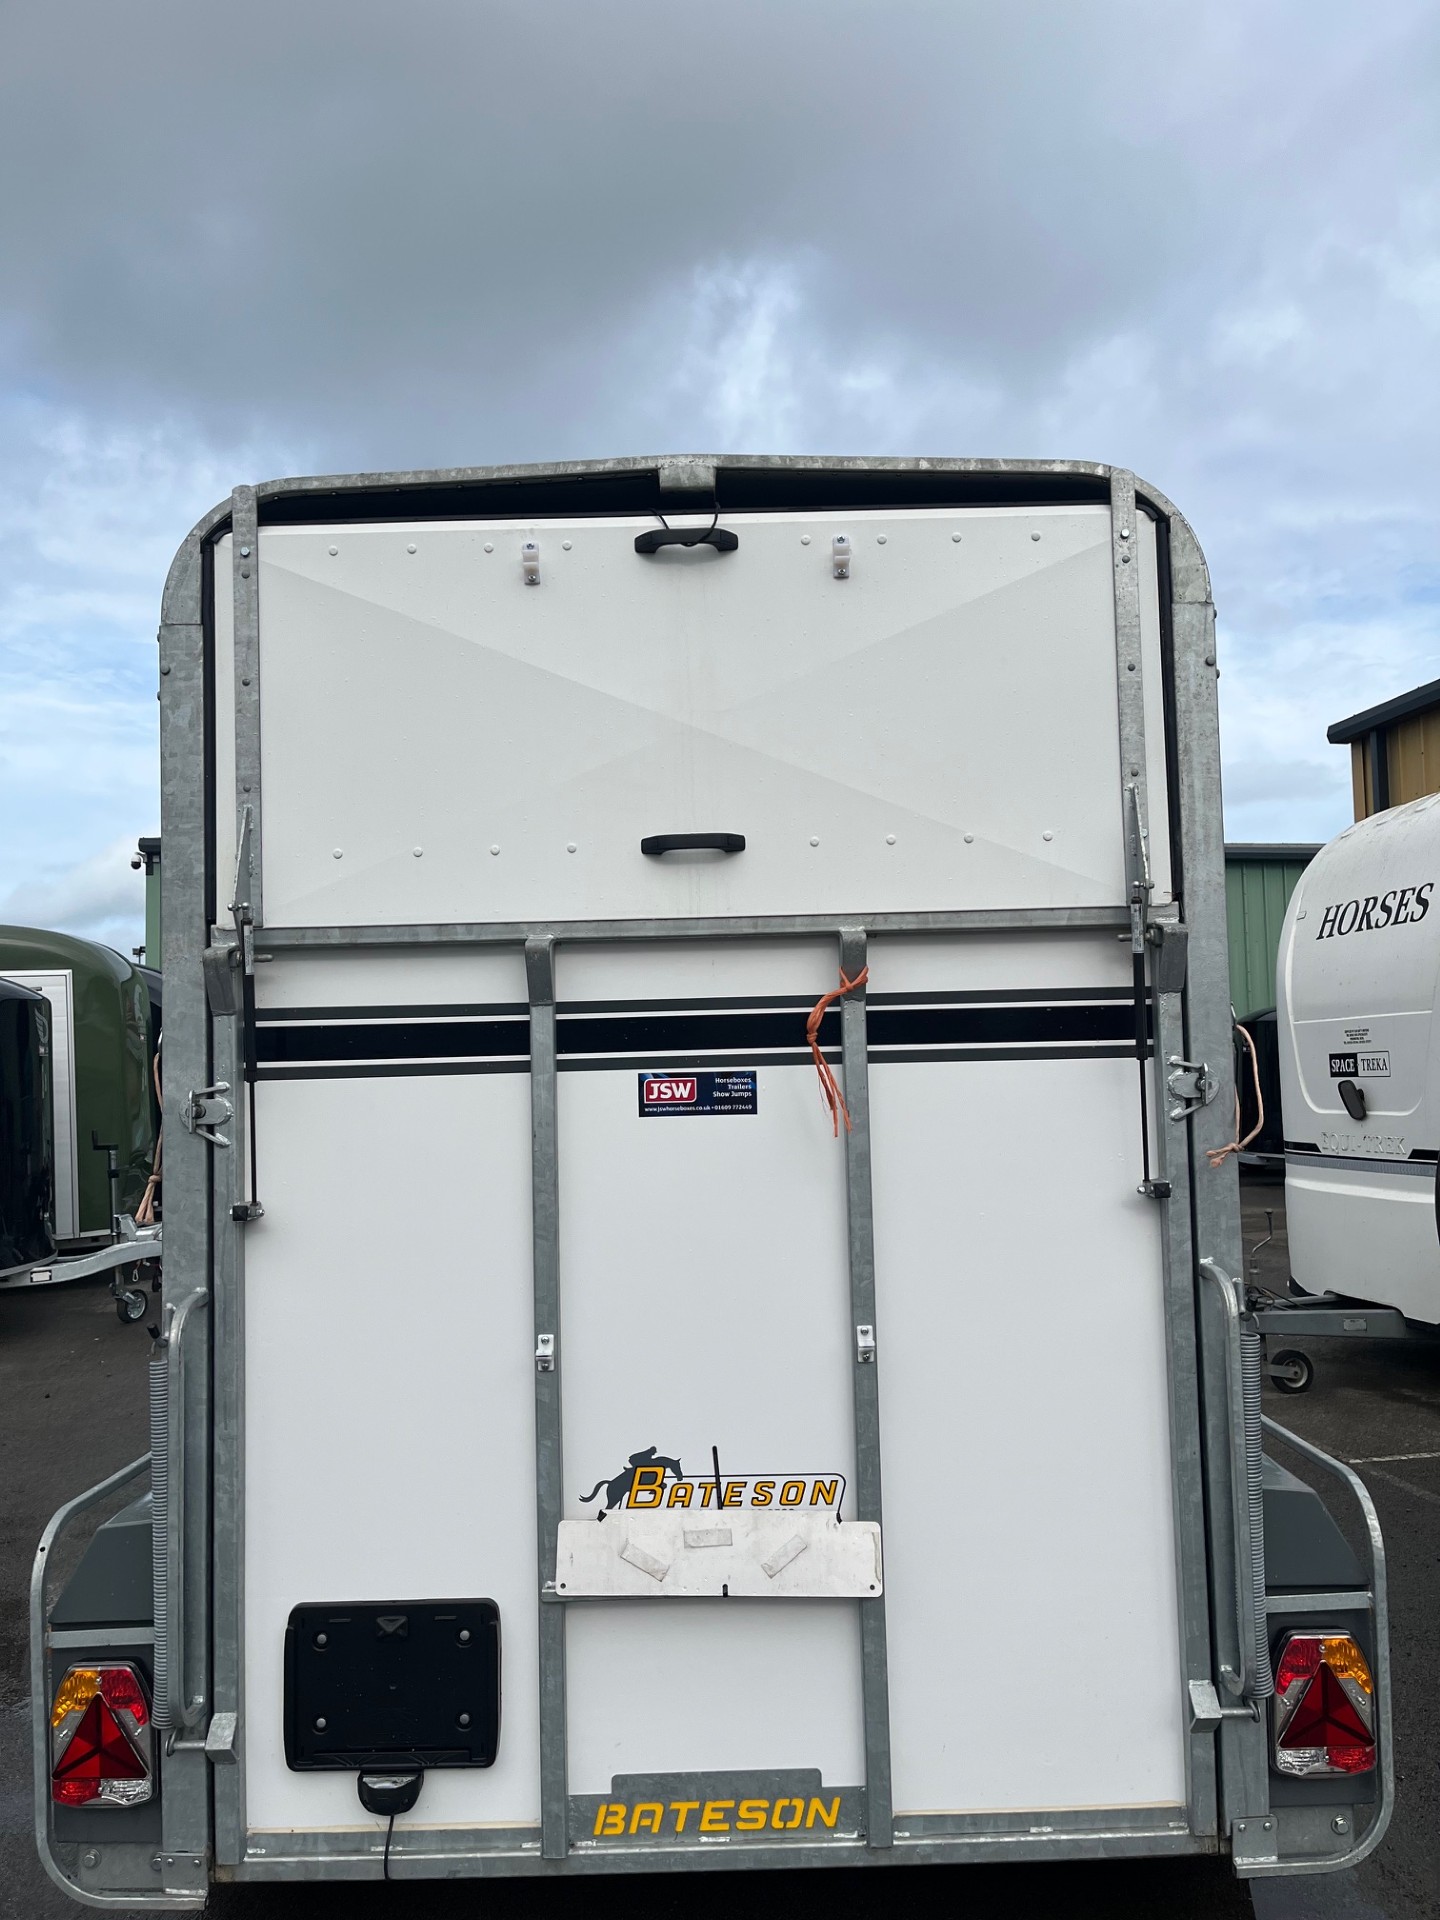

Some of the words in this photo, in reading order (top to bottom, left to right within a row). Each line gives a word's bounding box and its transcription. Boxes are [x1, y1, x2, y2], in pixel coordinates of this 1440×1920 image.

[1316, 882, 1434, 940] HORSES
[1331, 1059, 1355, 1072] SPACE
[1361, 1058, 1388, 1071] TREKA
[649, 1082, 692, 1099] JSW
[731, 1090, 752, 1098] Jumps
[626, 1465, 839, 1509] BATESON
[593, 1797, 840, 1836] BATESON
